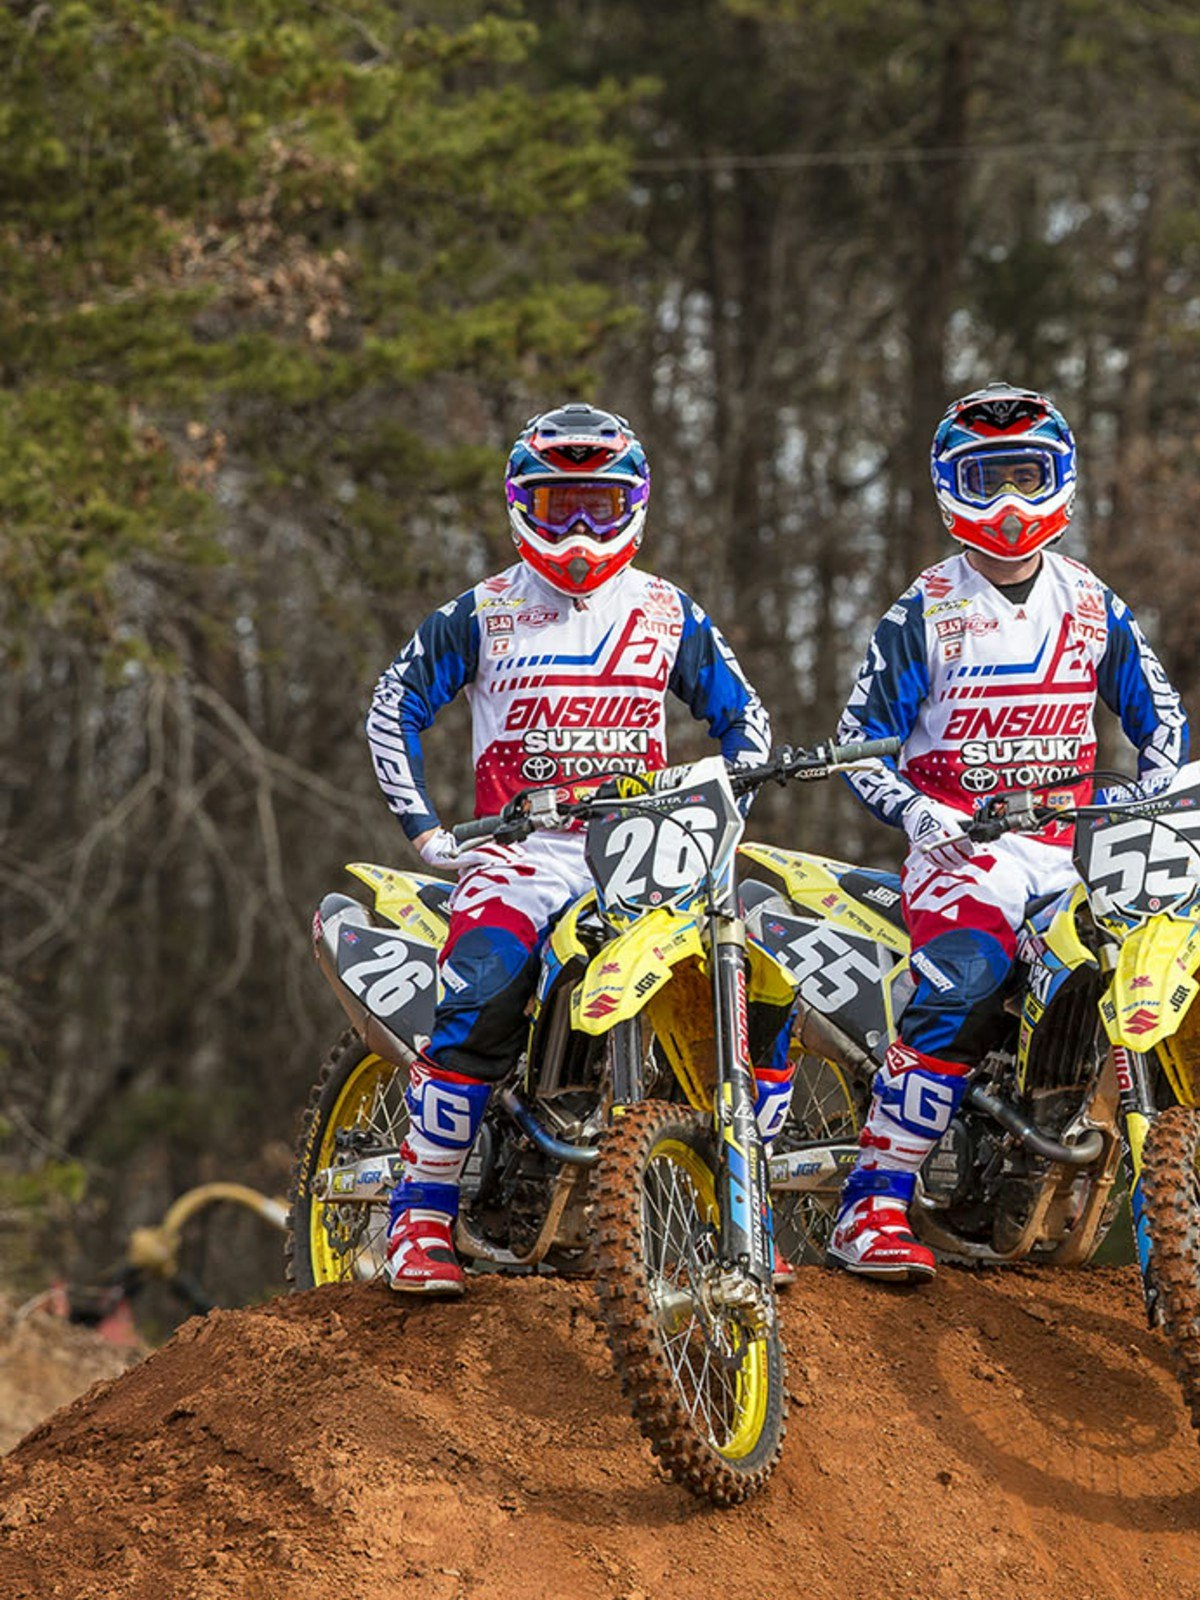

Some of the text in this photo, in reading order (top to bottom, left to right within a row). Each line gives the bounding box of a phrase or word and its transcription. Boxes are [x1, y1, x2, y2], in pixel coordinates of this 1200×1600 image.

[942, 702, 1092, 741] ANSWE
[523, 730, 649, 754] SUZUKI
[961, 739, 1082, 766] SUZUKI
[560, 757, 648, 776] TOYOTA
[605, 806, 718, 910] 26
[867, 886, 901, 905] JGR
[341, 939, 434, 1018] 26
[776, 926, 883, 1014] 55
[635, 971, 662, 999] JGR
[1169, 984, 1192, 1013] JGR
[357, 1170, 382, 1184] JGR
[791, 1162, 822, 1177] JGR
[750, 1184, 764, 1265] DUNLOP
